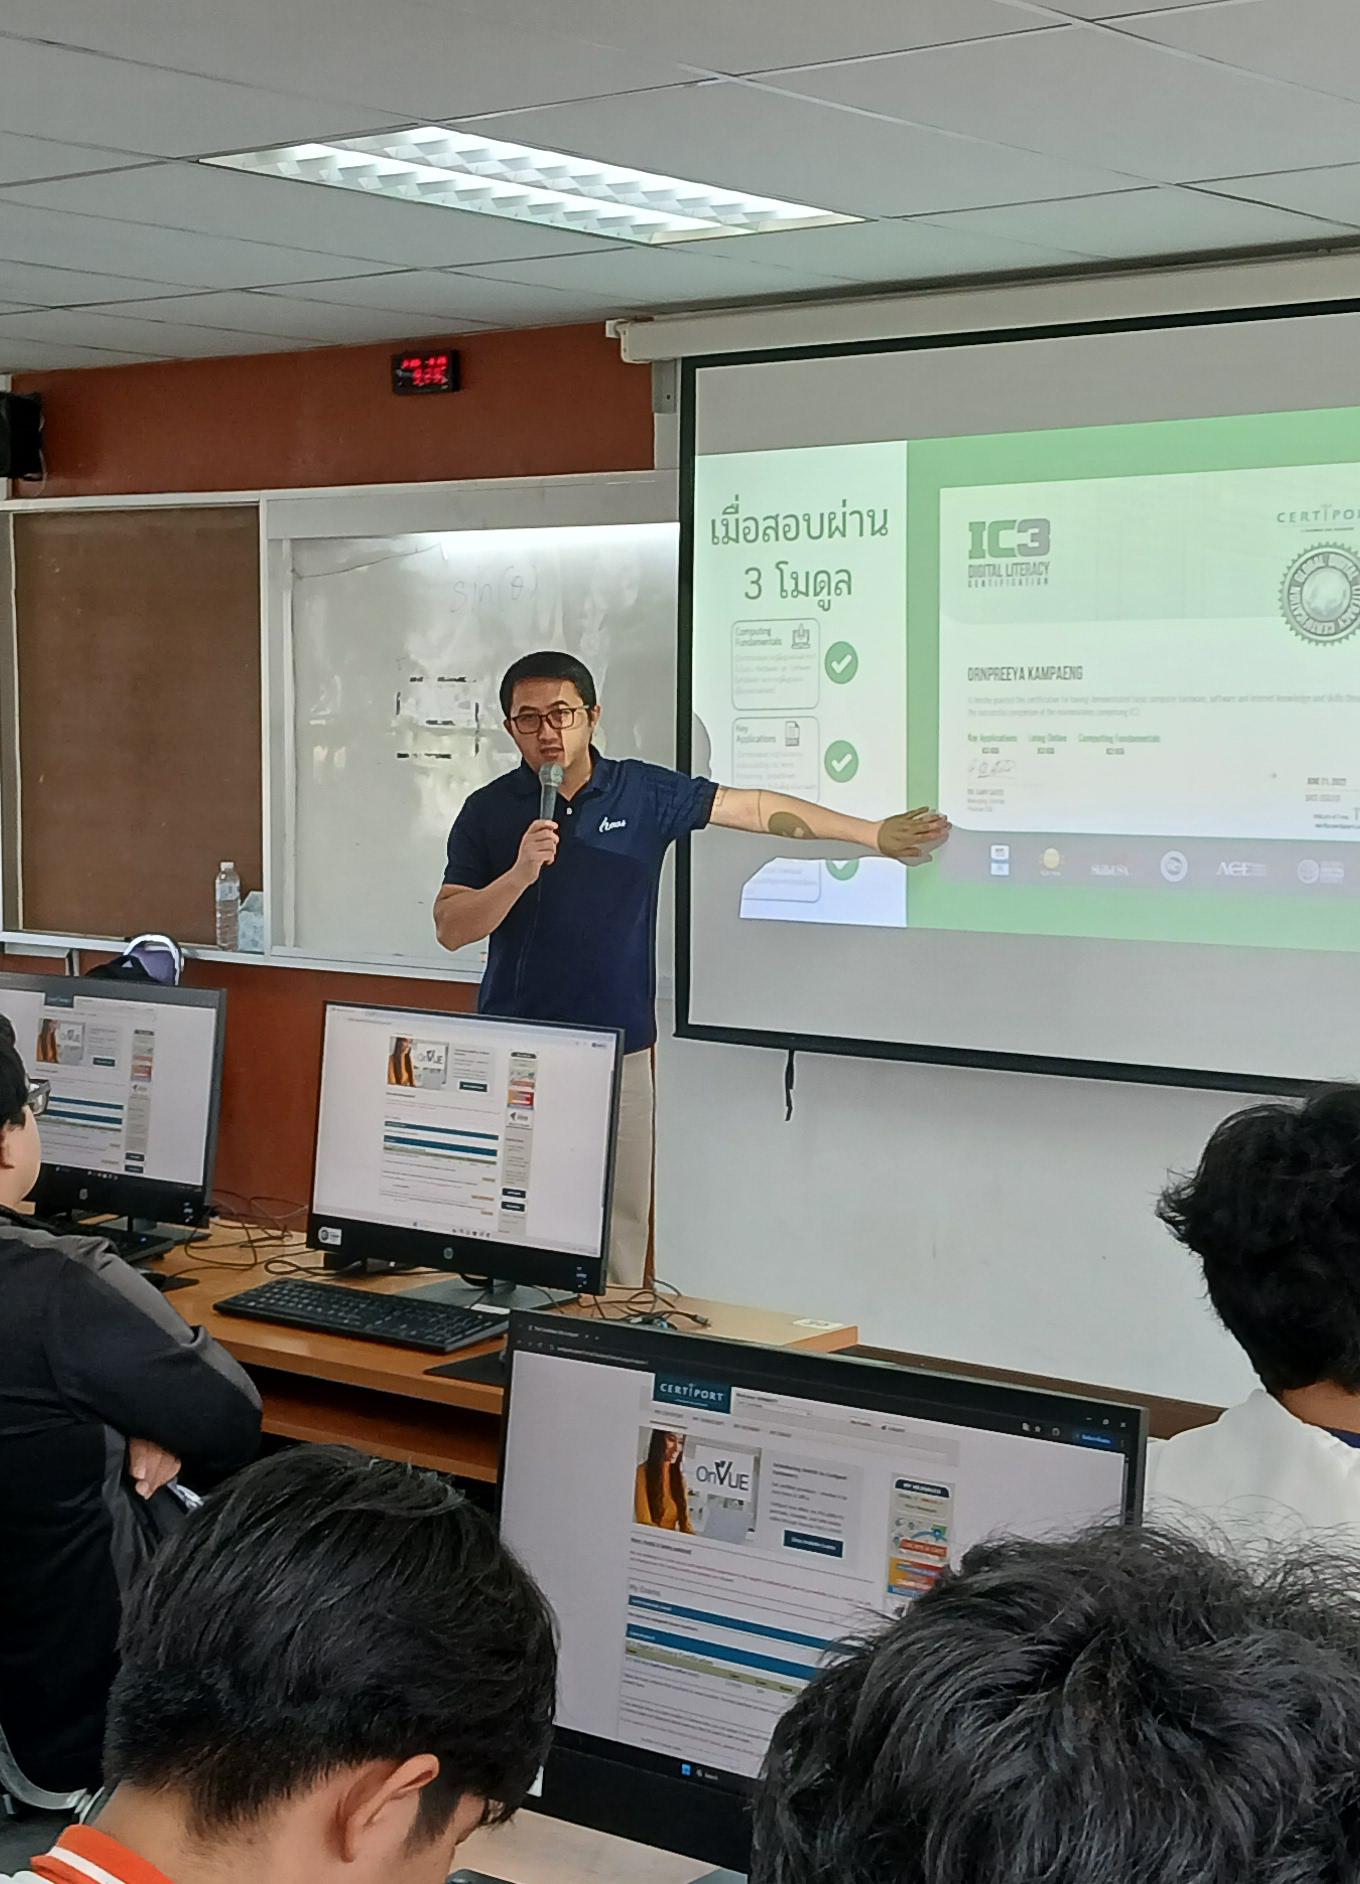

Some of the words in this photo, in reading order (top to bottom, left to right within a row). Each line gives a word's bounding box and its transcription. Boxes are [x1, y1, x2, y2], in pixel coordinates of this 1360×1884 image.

[710, 494, 889, 546] เมื่อสอบผ่าน
[968, 518, 1051, 560] IC3
[744, 566, 762, 600] 3
[775, 560, 853, 612] โมดูล
[659, 1383, 725, 1402] CERTIPORT
[696, 1460, 751, 1492] OnVUE
